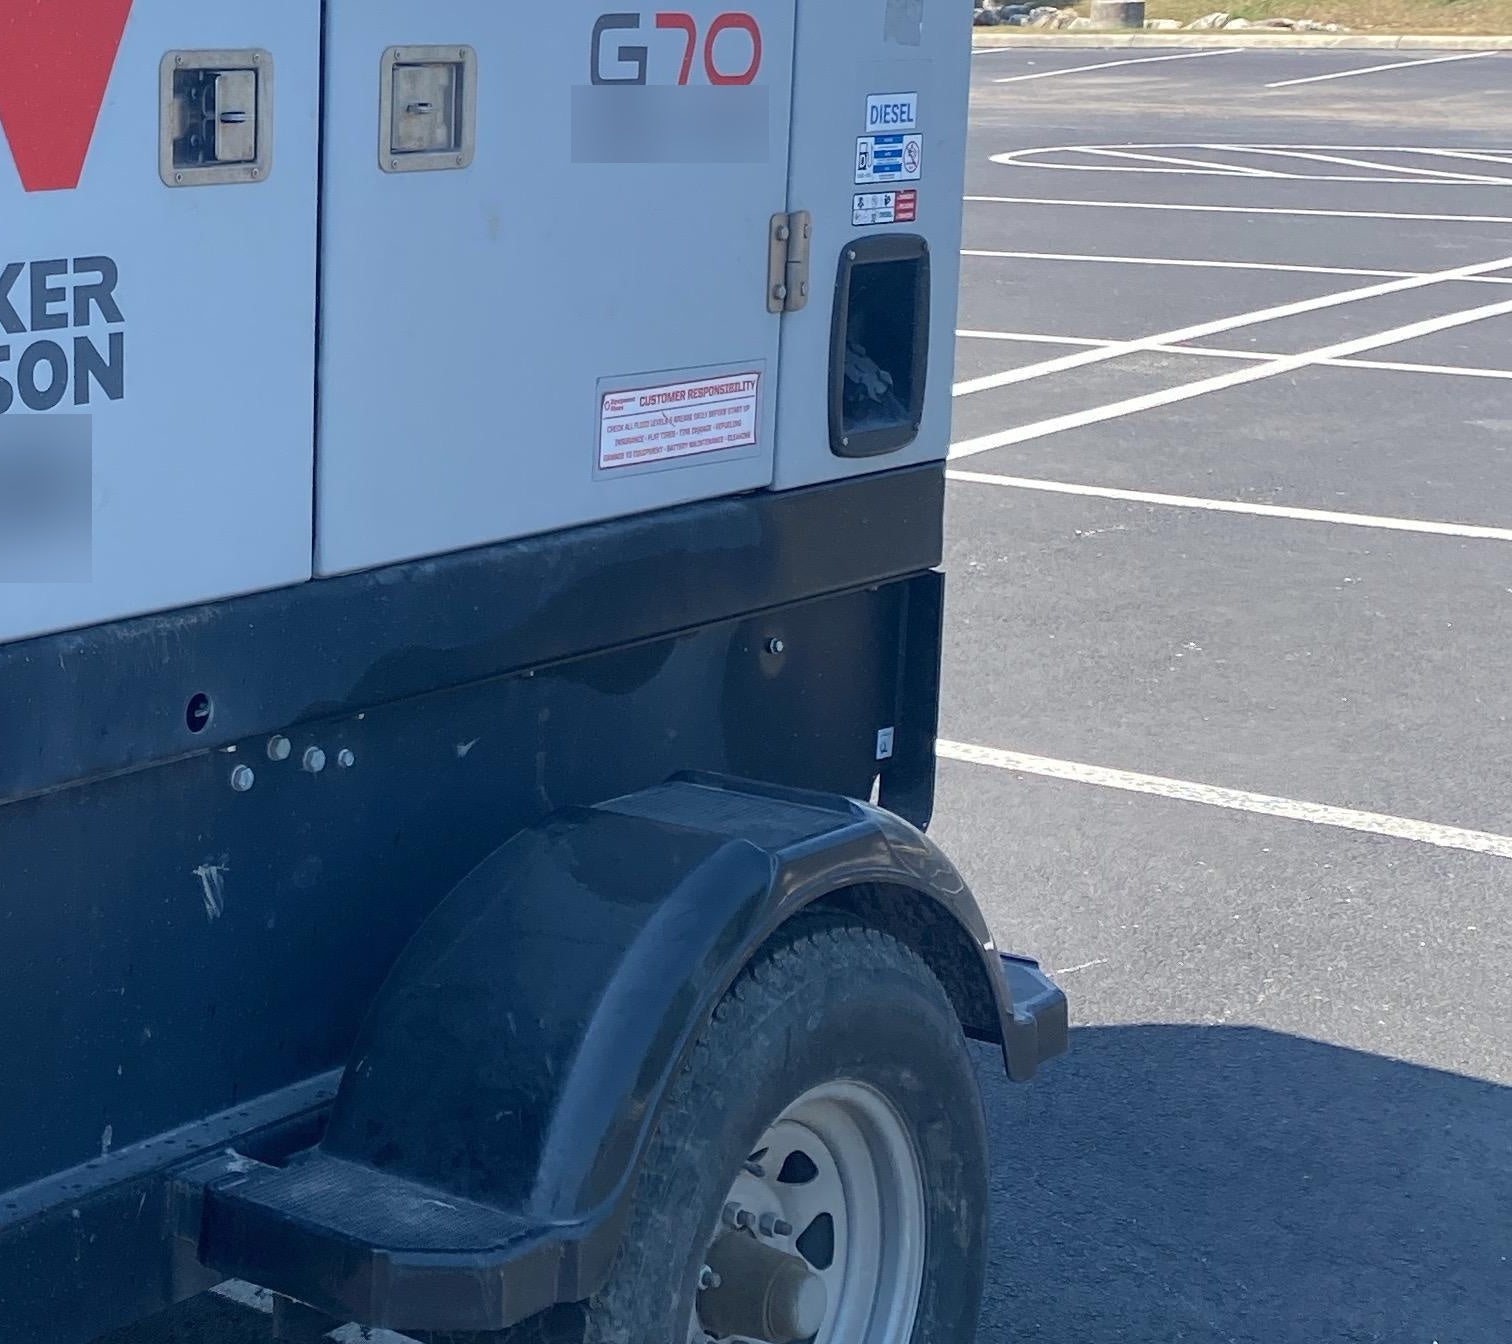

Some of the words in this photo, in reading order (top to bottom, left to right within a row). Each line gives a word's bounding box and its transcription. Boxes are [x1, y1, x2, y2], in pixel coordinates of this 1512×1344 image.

[590, 12, 763, 86] G70
[870, 103, 914, 125] DIESEL
[639, 390, 686, 407] CUSTOMER
[687, 380, 756, 401] RESPONSIBILITY
